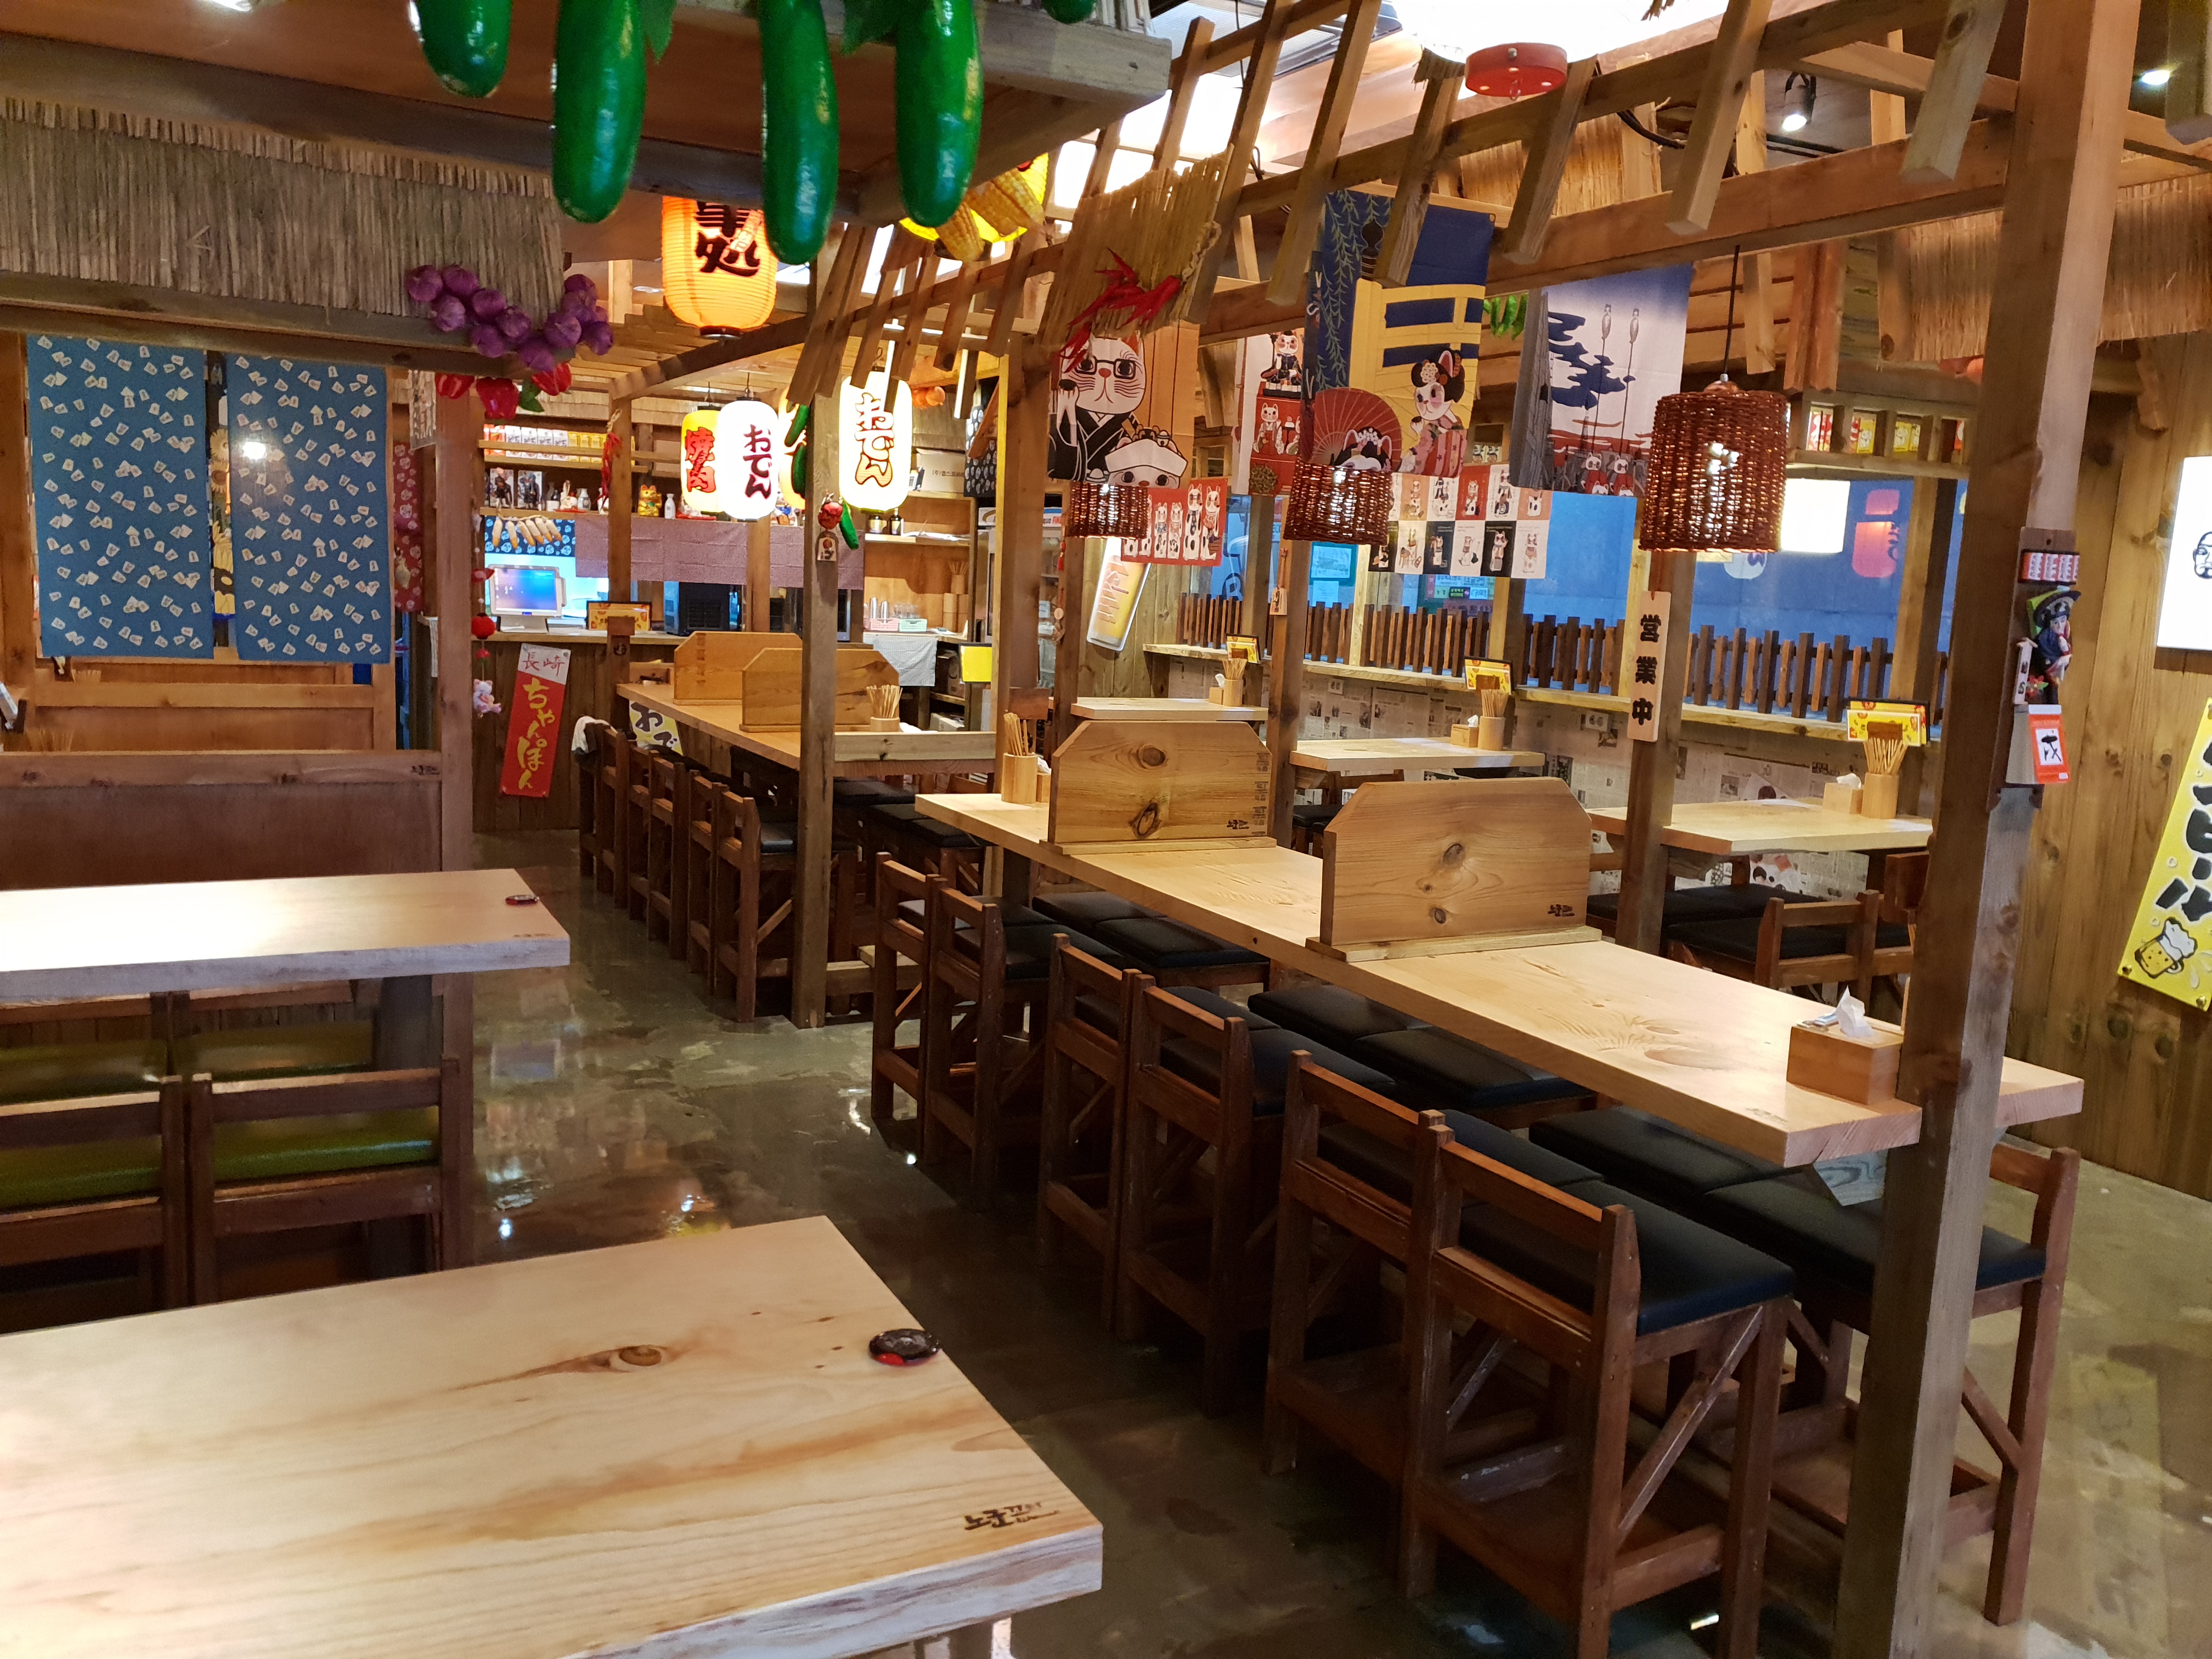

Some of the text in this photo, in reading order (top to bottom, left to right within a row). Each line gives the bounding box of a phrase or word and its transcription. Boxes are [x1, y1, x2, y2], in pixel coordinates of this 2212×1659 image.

[743, 424, 772, 500] おでん
[522, 652, 565, 676] 長崎
[1632, 614, 1662, 726] 営業中
[517, 677, 556, 790] ちゃんぽん
